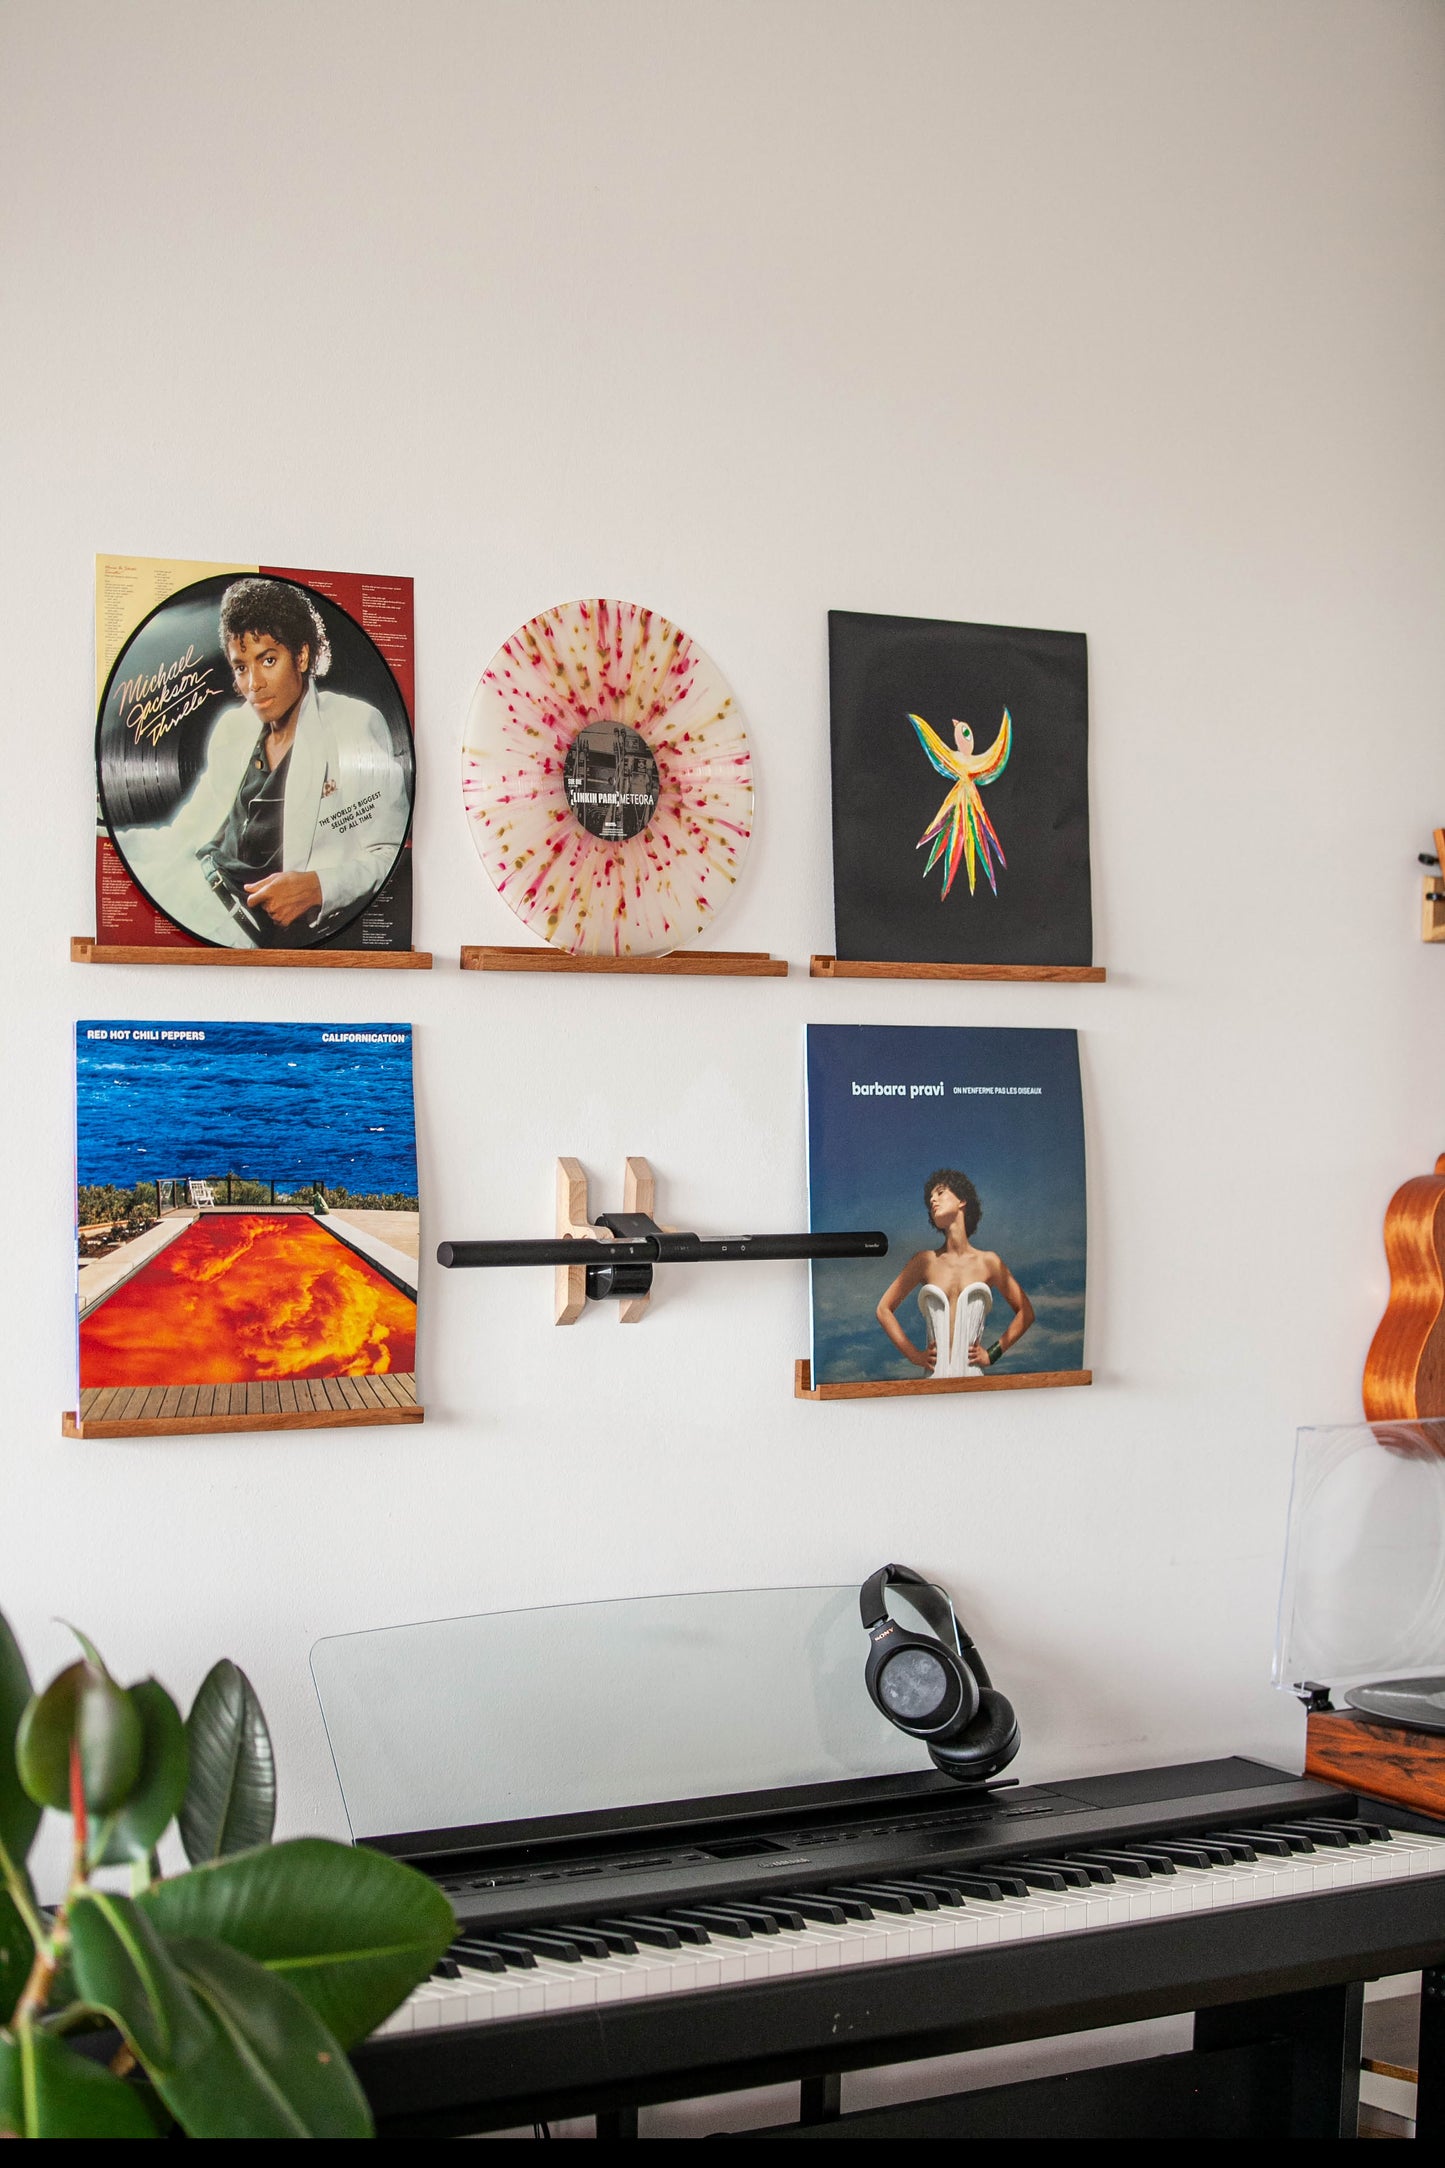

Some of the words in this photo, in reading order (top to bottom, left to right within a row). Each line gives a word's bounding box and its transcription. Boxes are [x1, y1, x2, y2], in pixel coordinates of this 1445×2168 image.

[113, 645, 204, 716] Michael
[127, 668, 214, 745] Jackson
[147, 688, 224, 746] Thriller
[319, 817, 330, 827] THE
[330, 803, 357, 821] WORLD'S
[357, 791, 381, 808] BIGGEST
[619, 792, 654, 806] METEORA
[331, 813, 354, 829] SELLING
[355, 803, 375, 817] ALBUM
[339, 825, 347, 834] OF
[349, 820, 359, 829] ALL
[358, 812, 373, 823] TIME
[87, 1030, 108, 1040] RED
[110, 1030, 131, 1040] HOT
[132, 1030, 159, 1041] CHILI
[161, 1031, 205, 1041] PEPPERS
[321, 1033, 405, 1043] CALIFORNICATION
[852, 1081, 906, 1096] barbara
[910, 1081, 945, 1099] pravi
[953, 1086, 962, 1095] ON
[994, 1086, 1006, 1095] PAS
[1006, 1086, 1018, 1095] LES
[1018, 1087, 1042, 1095] OISEAUX
